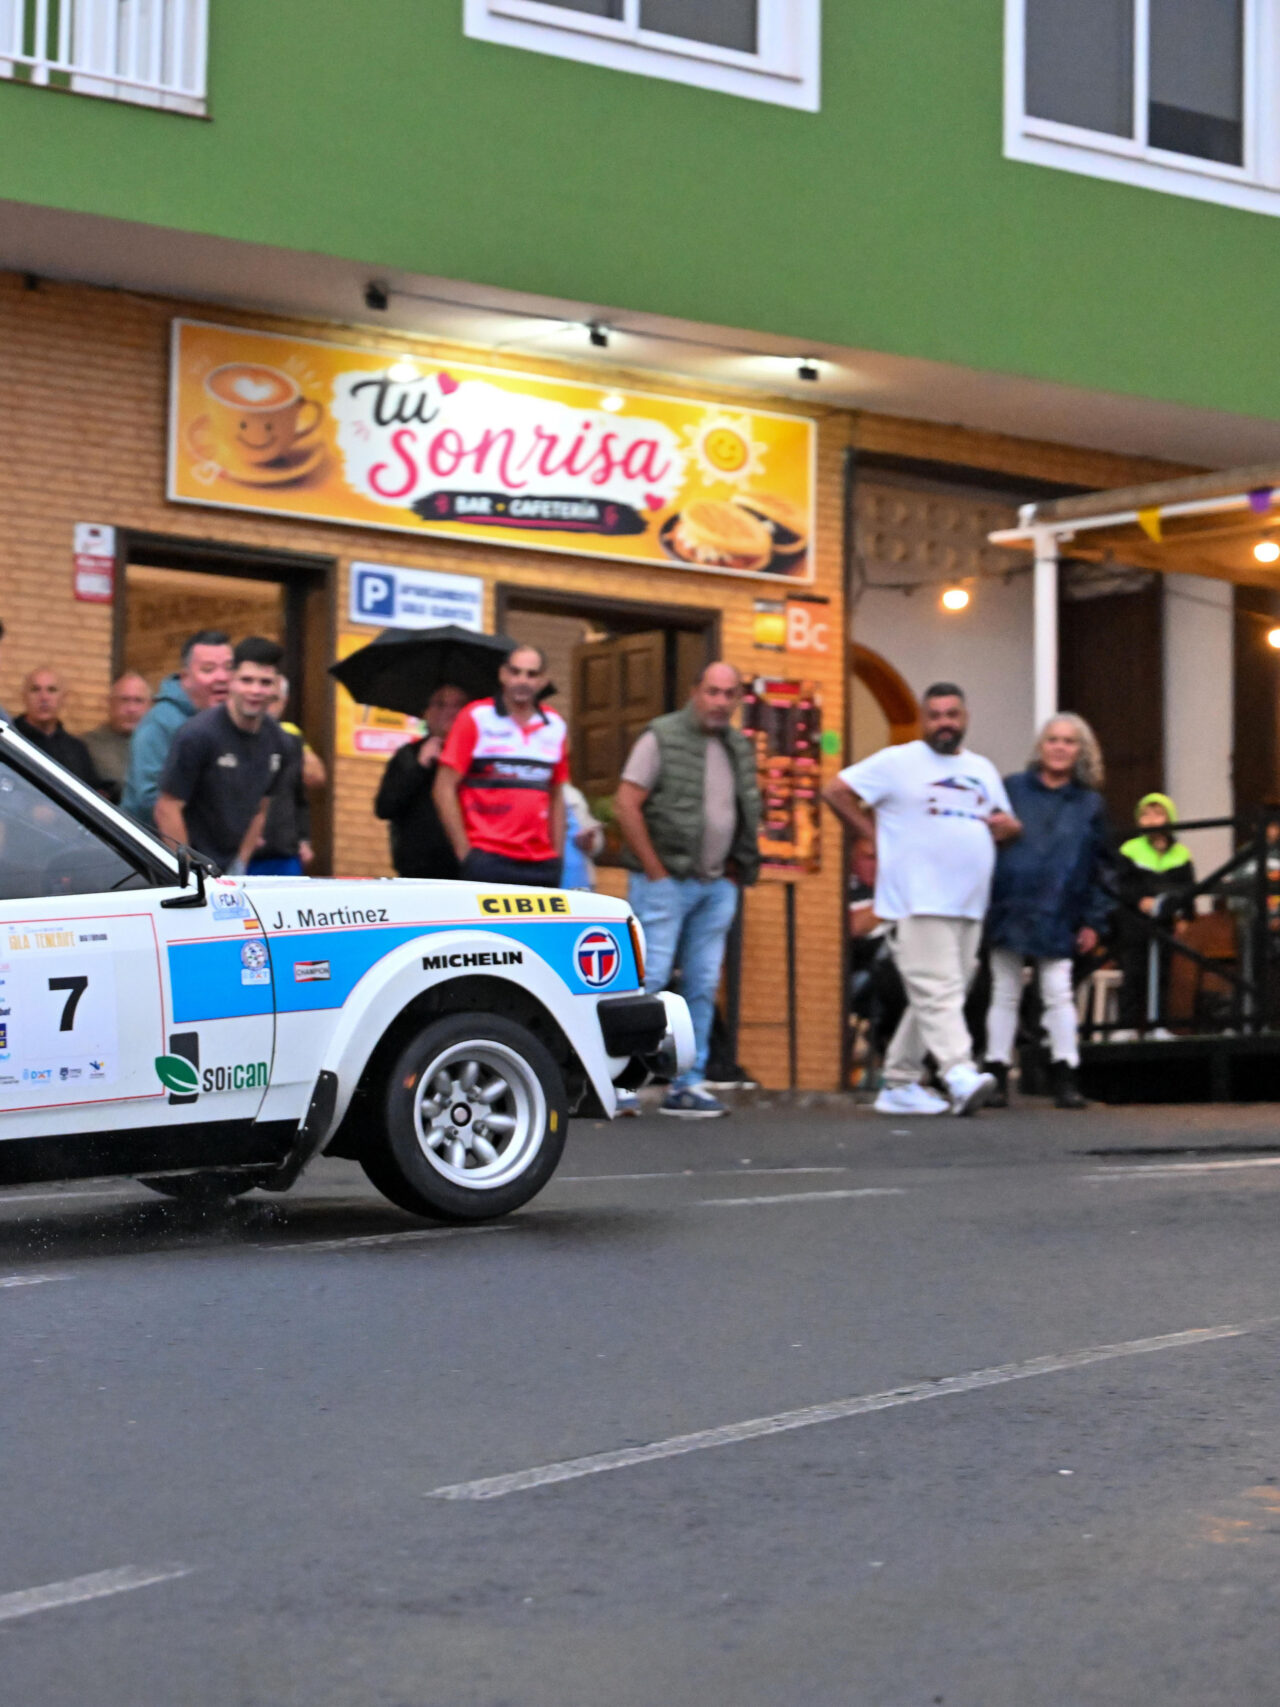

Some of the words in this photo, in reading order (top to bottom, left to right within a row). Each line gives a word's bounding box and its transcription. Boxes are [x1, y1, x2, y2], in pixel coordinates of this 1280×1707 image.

[454, 495, 493, 514] BAR
[362, 576, 390, 611] P
[273, 911, 291, 929] J.
[422, 951, 523, 970] MICHELIN
[48, 975, 88, 1031] 7
